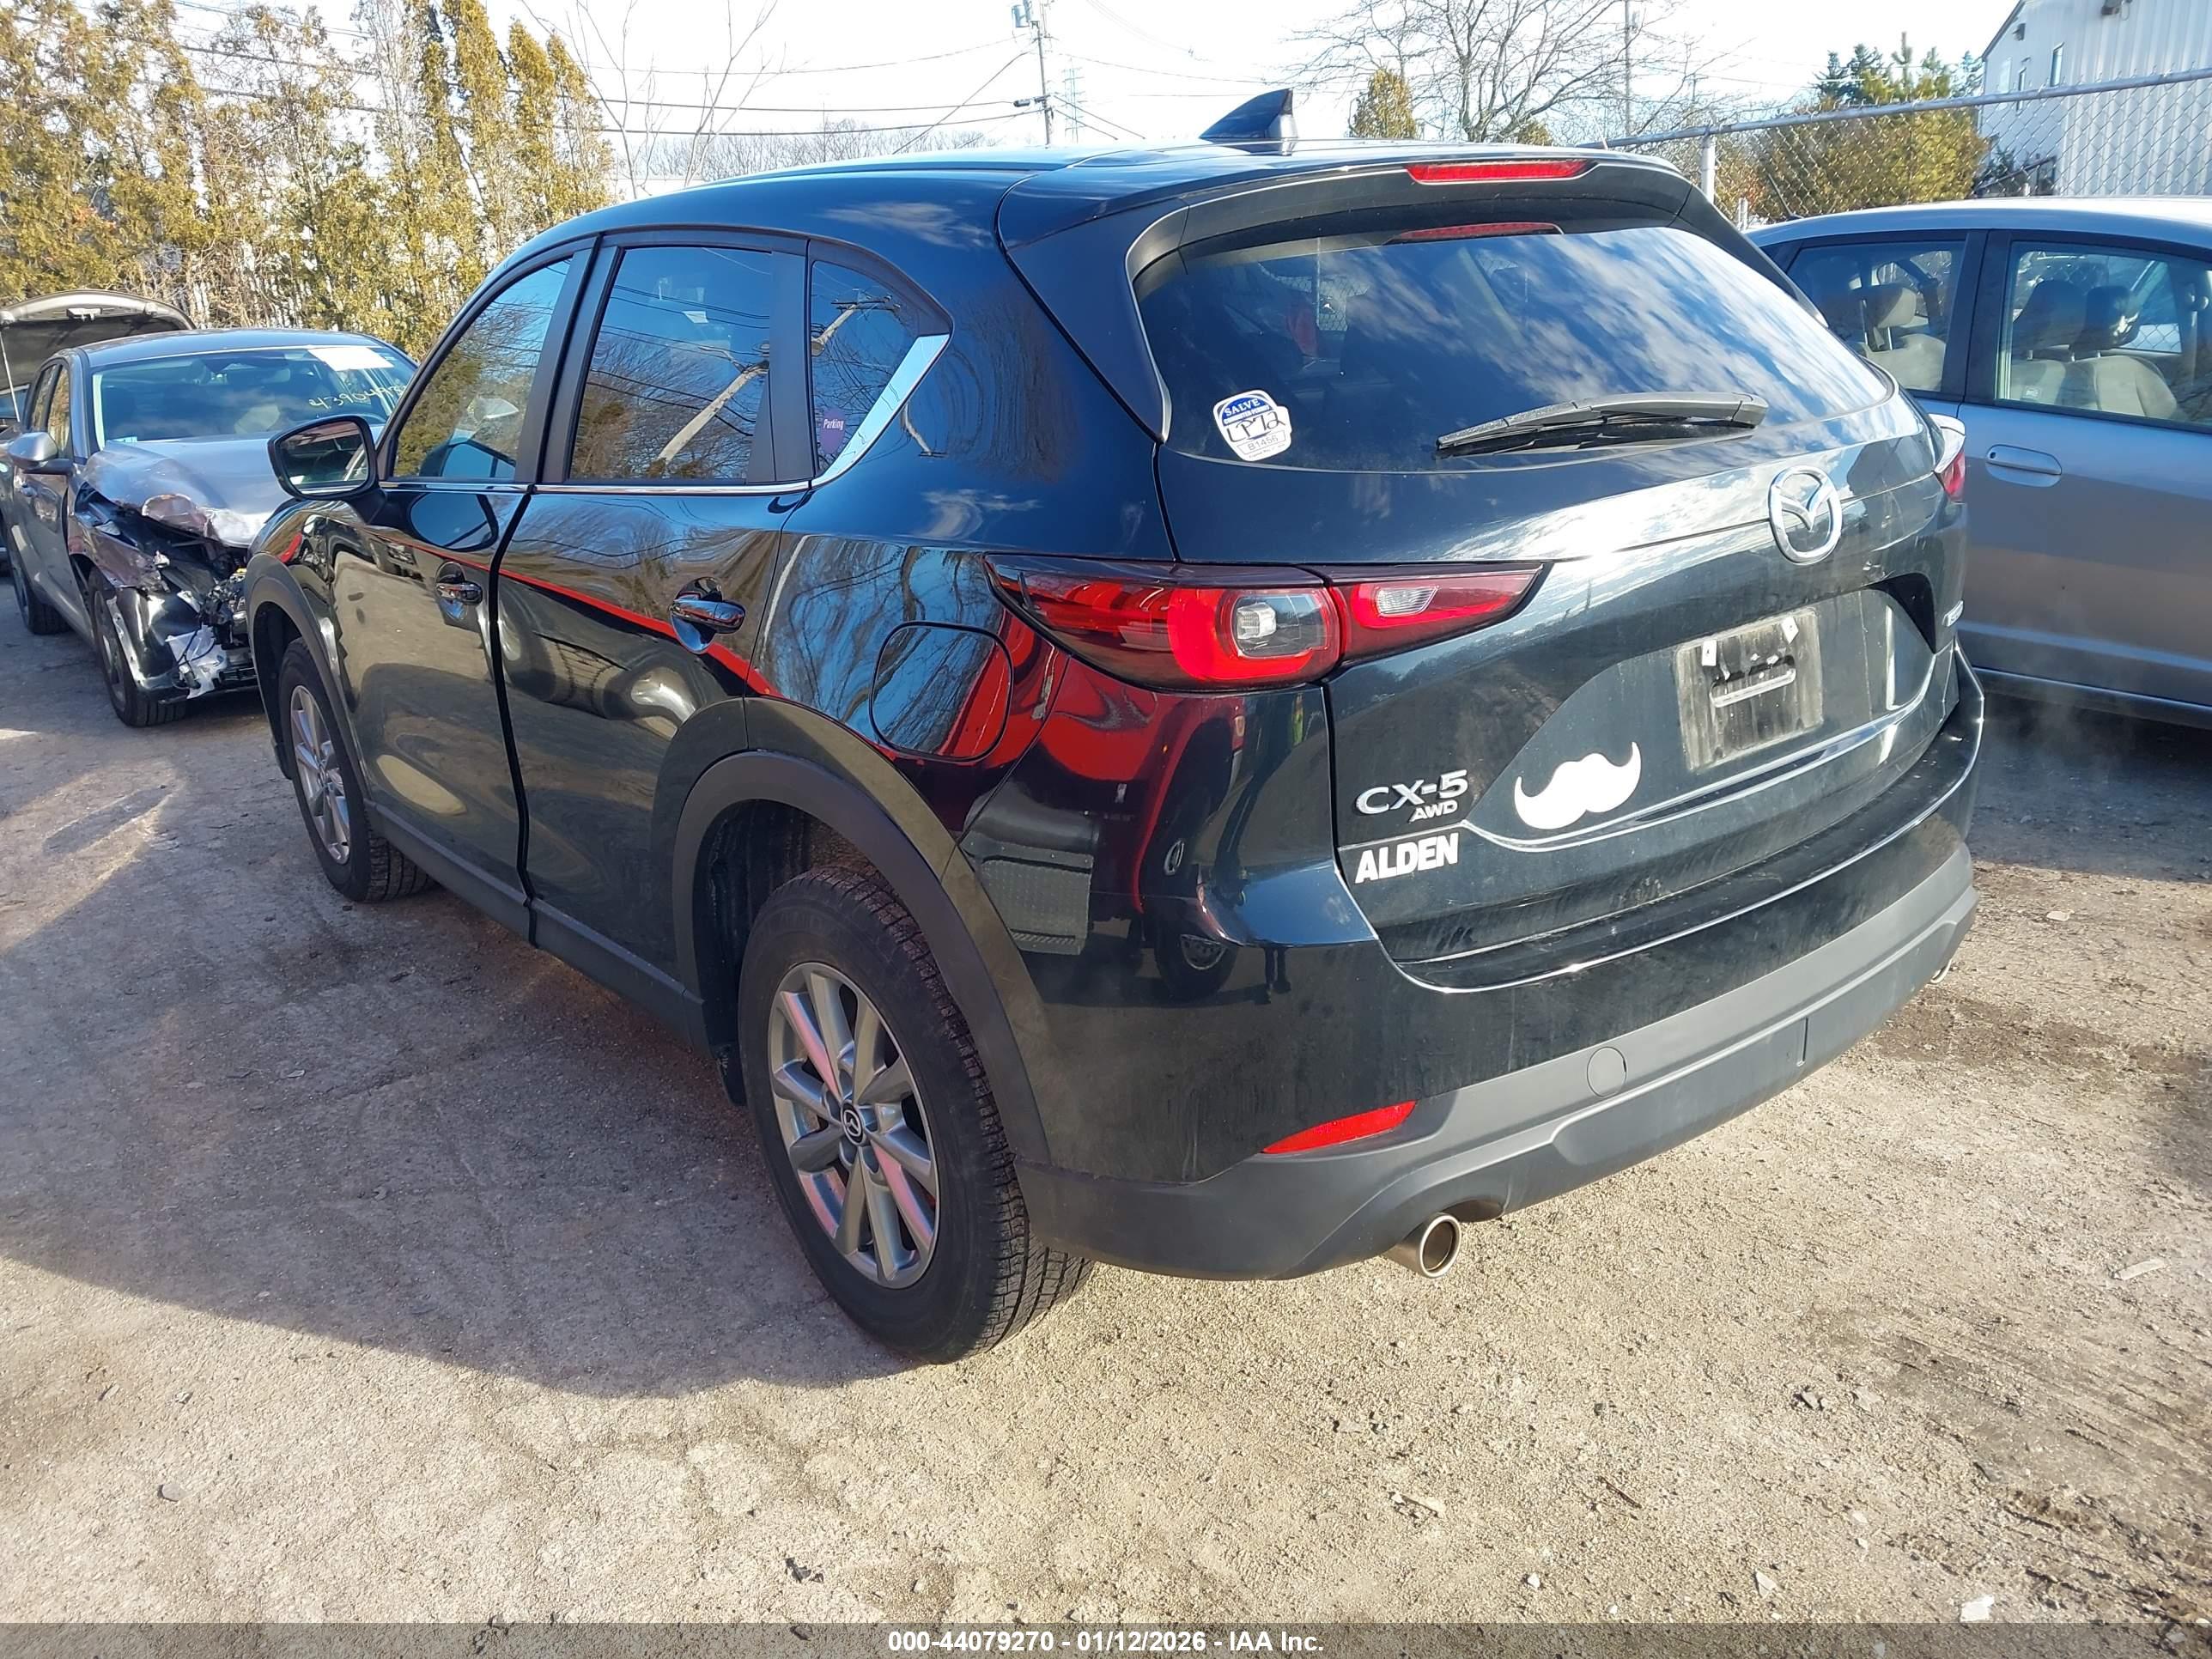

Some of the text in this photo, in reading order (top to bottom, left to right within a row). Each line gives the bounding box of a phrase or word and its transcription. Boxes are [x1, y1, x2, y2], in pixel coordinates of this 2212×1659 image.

[1224, 398, 1261, 416] SALVE
[823, 418, 844, 431] Parking
[1248, 435, 1279, 450] B1456
[1355, 769, 1468, 815] CX-5
[1408, 799, 1458, 823] AWD
[1354, 832, 1459, 884] ALDEN
